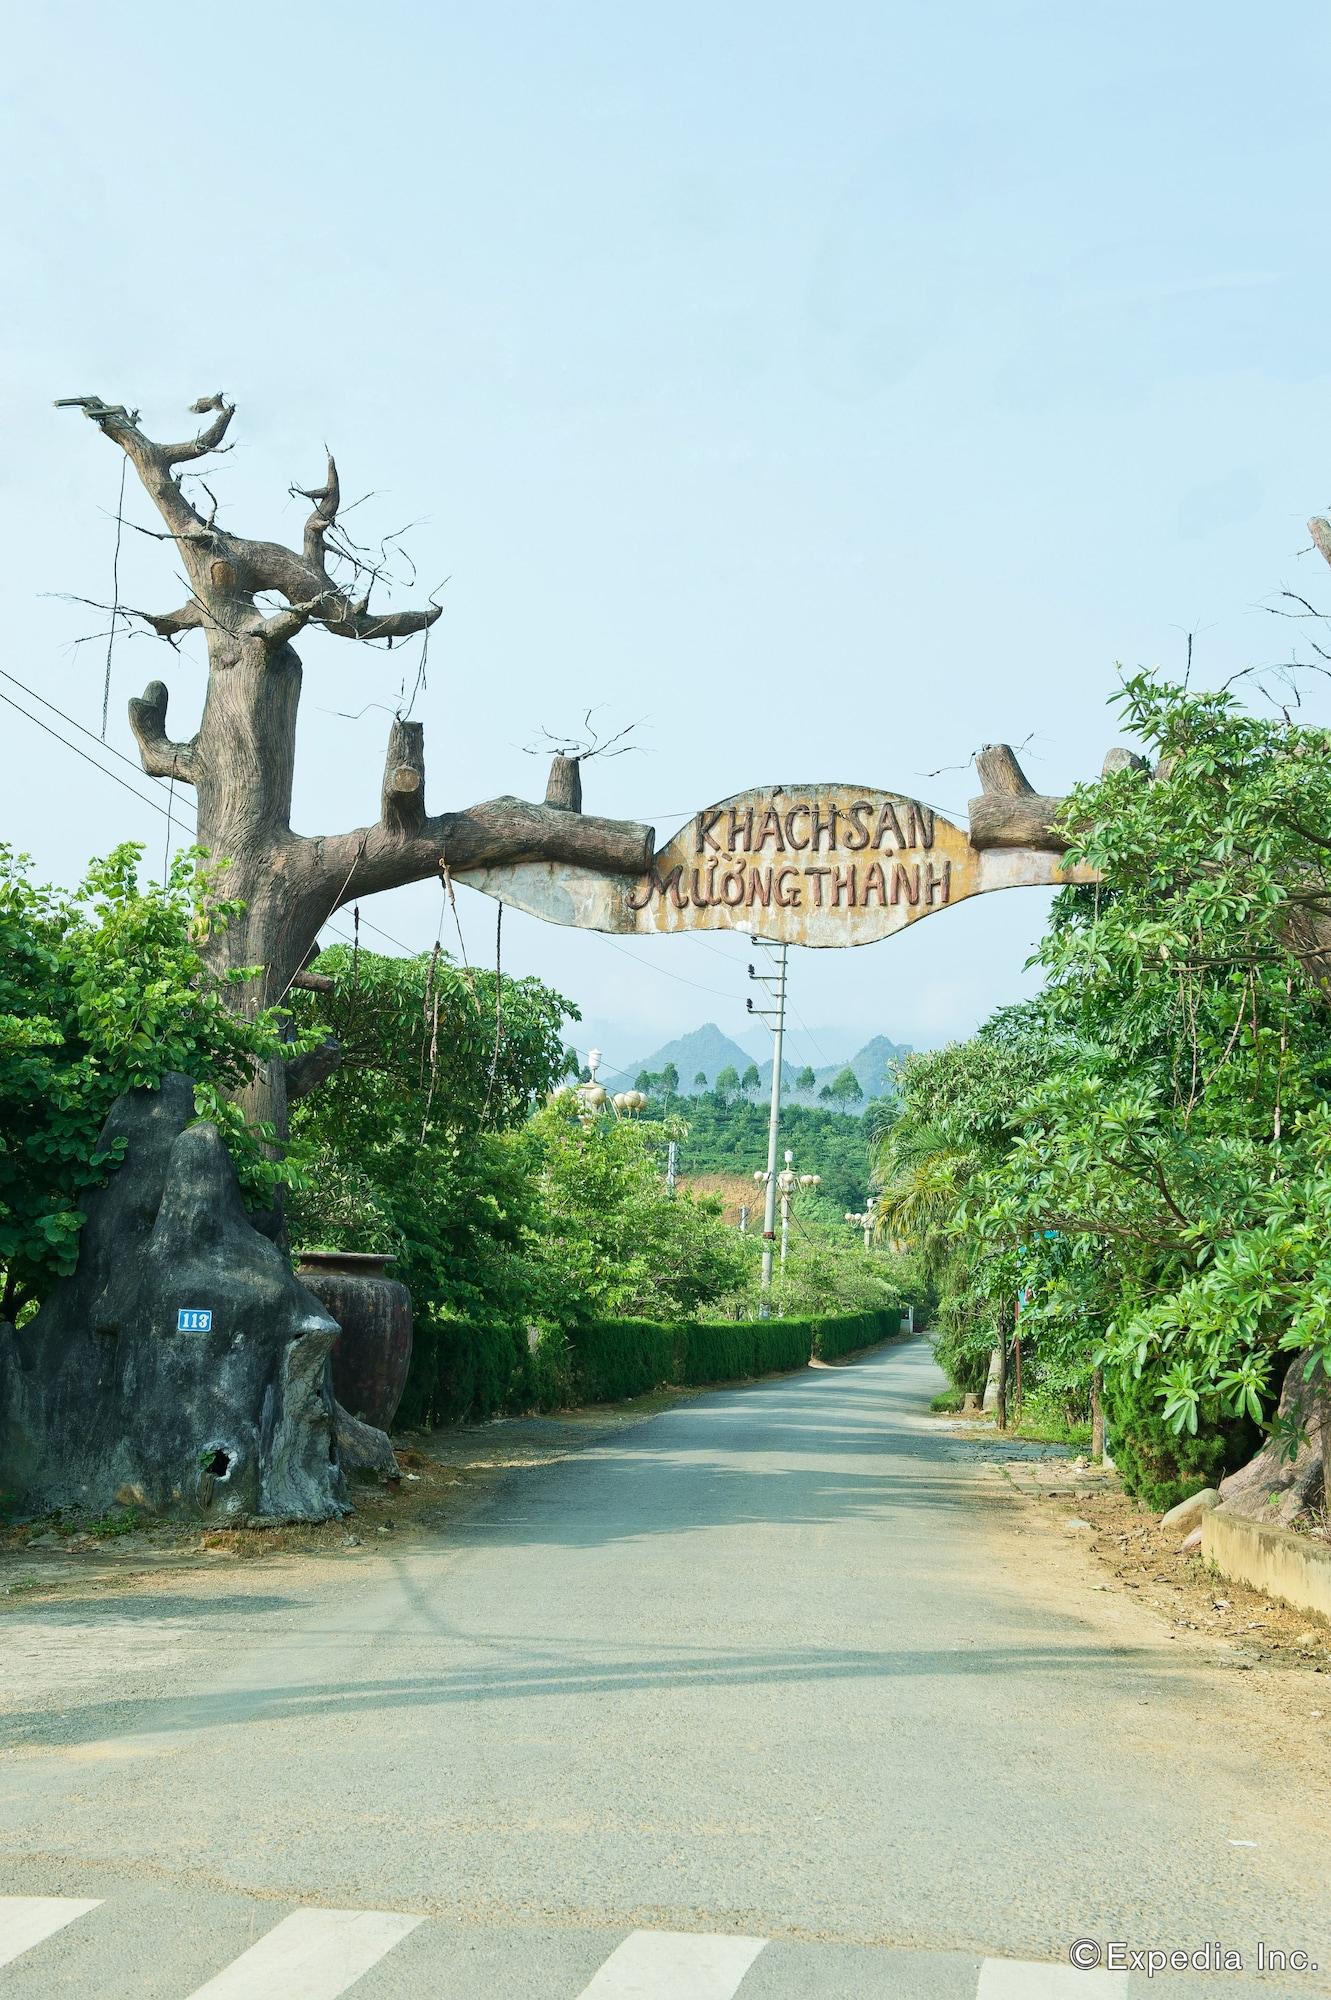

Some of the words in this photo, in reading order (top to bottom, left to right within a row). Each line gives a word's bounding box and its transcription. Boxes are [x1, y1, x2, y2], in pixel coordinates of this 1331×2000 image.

[695, 786, 837, 853] KHÁCH
[804, 860, 951, 908] THANH
[182, 1312, 209, 1328] 113
